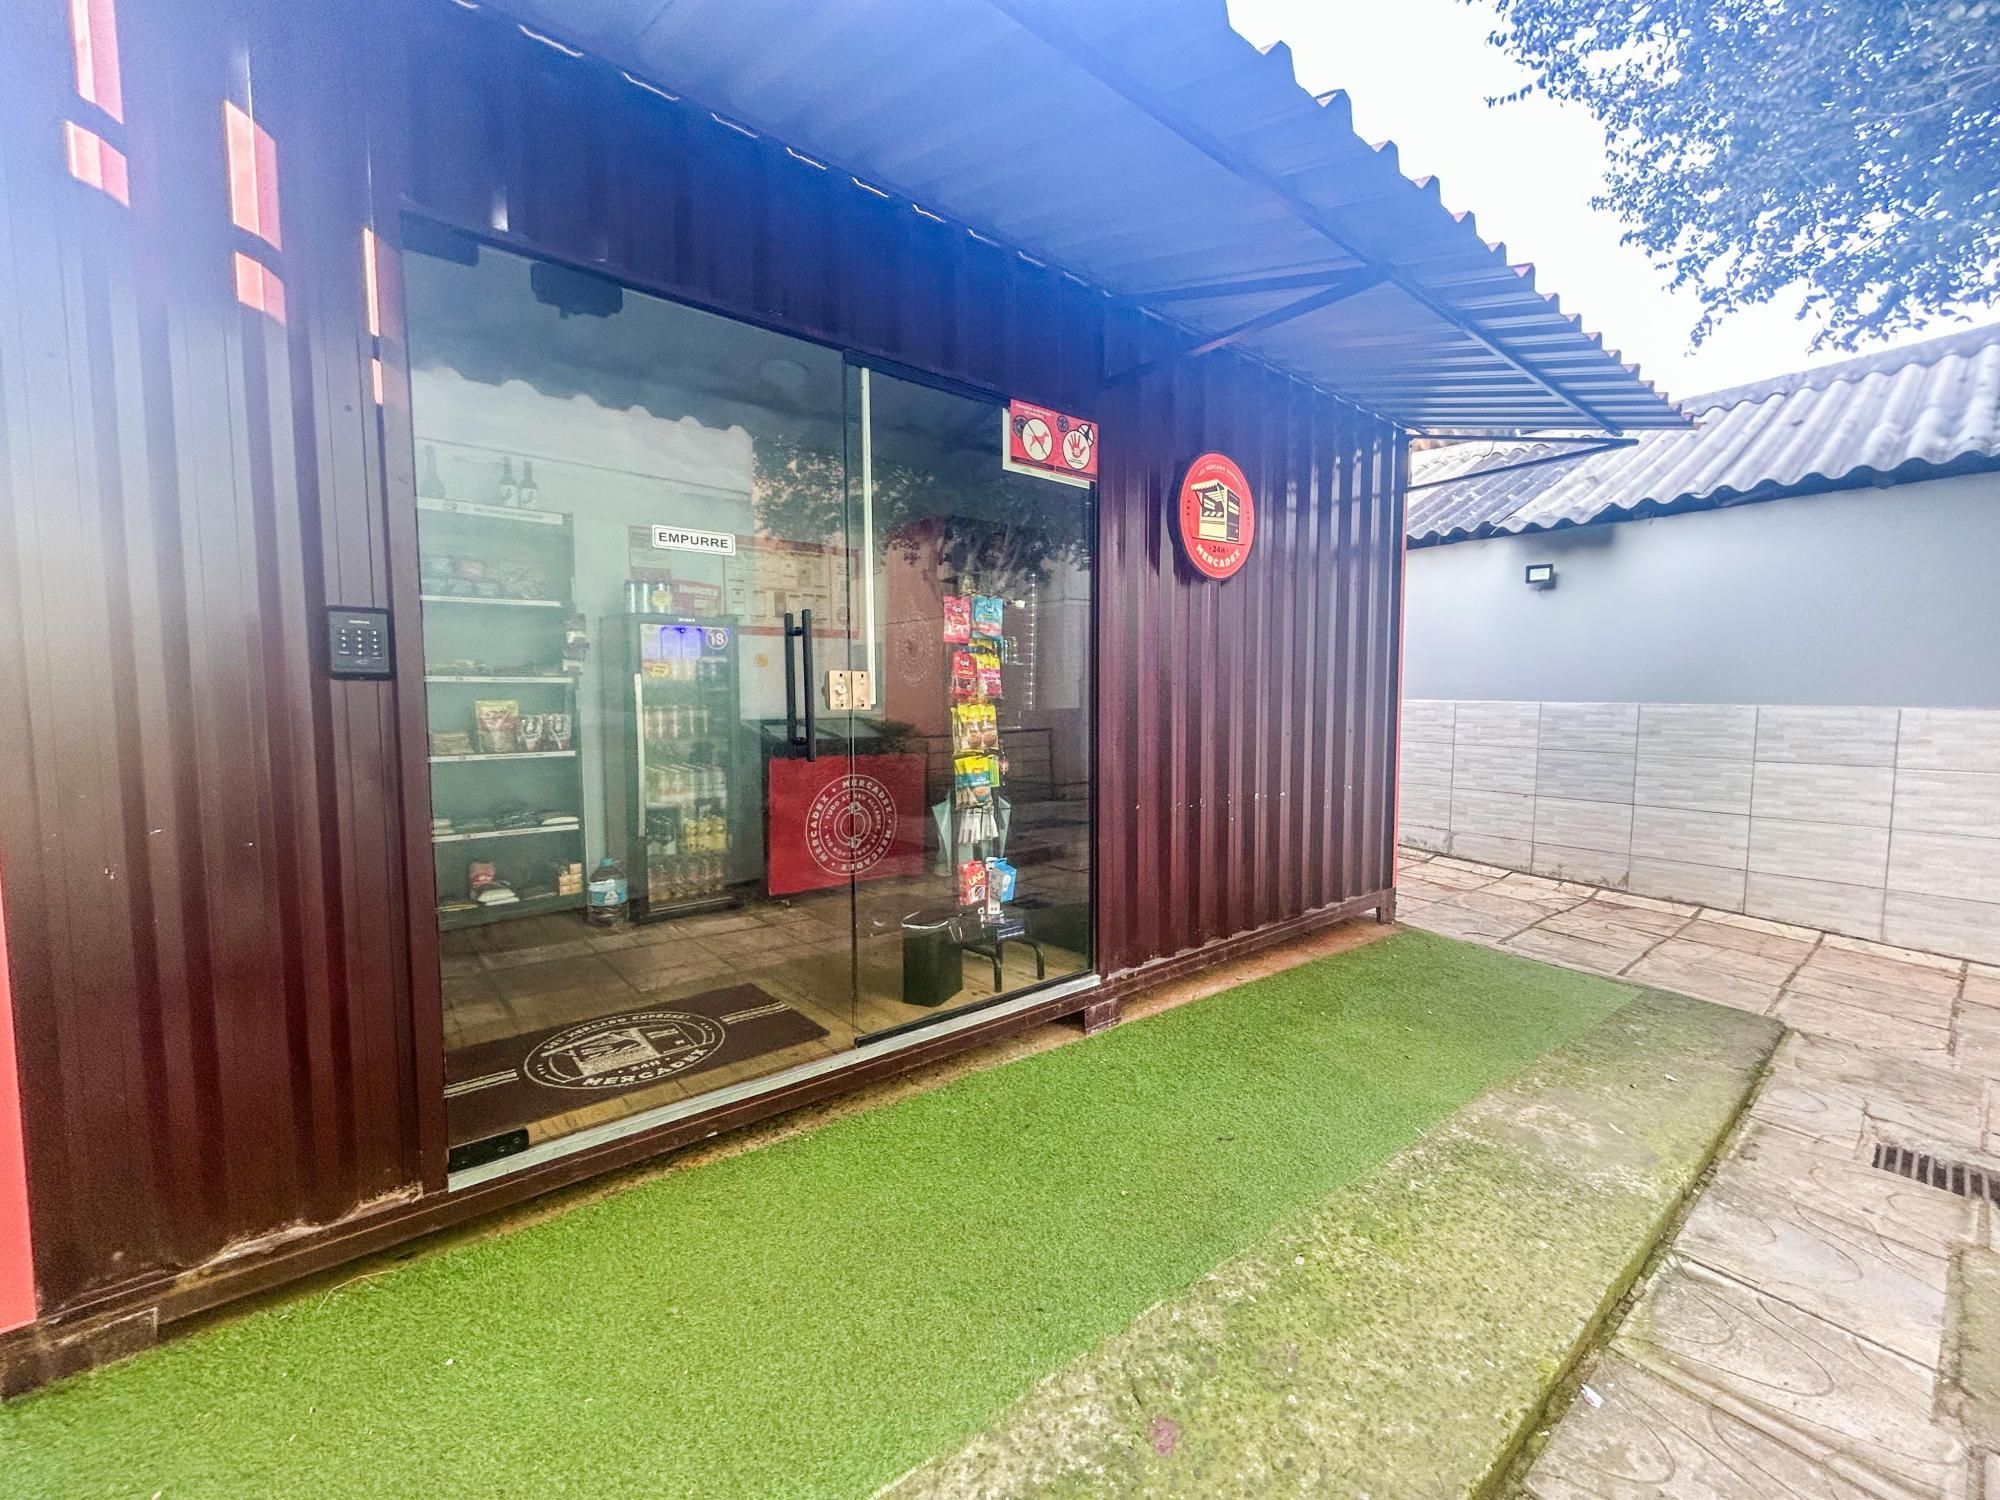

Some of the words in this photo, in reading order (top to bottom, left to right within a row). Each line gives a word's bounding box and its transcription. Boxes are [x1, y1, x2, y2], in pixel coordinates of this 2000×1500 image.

[658, 532, 728, 549] EMPURRE
[1196, 543, 1240, 568] MERCADEX
[842, 779, 892, 813] MERCADEX
[811, 794, 829, 862] MERCADEX
[969, 870, 986, 886] UNO
[568, 1017, 627, 1037] MERCADO
[582, 1049, 709, 1087] MERCADEX
